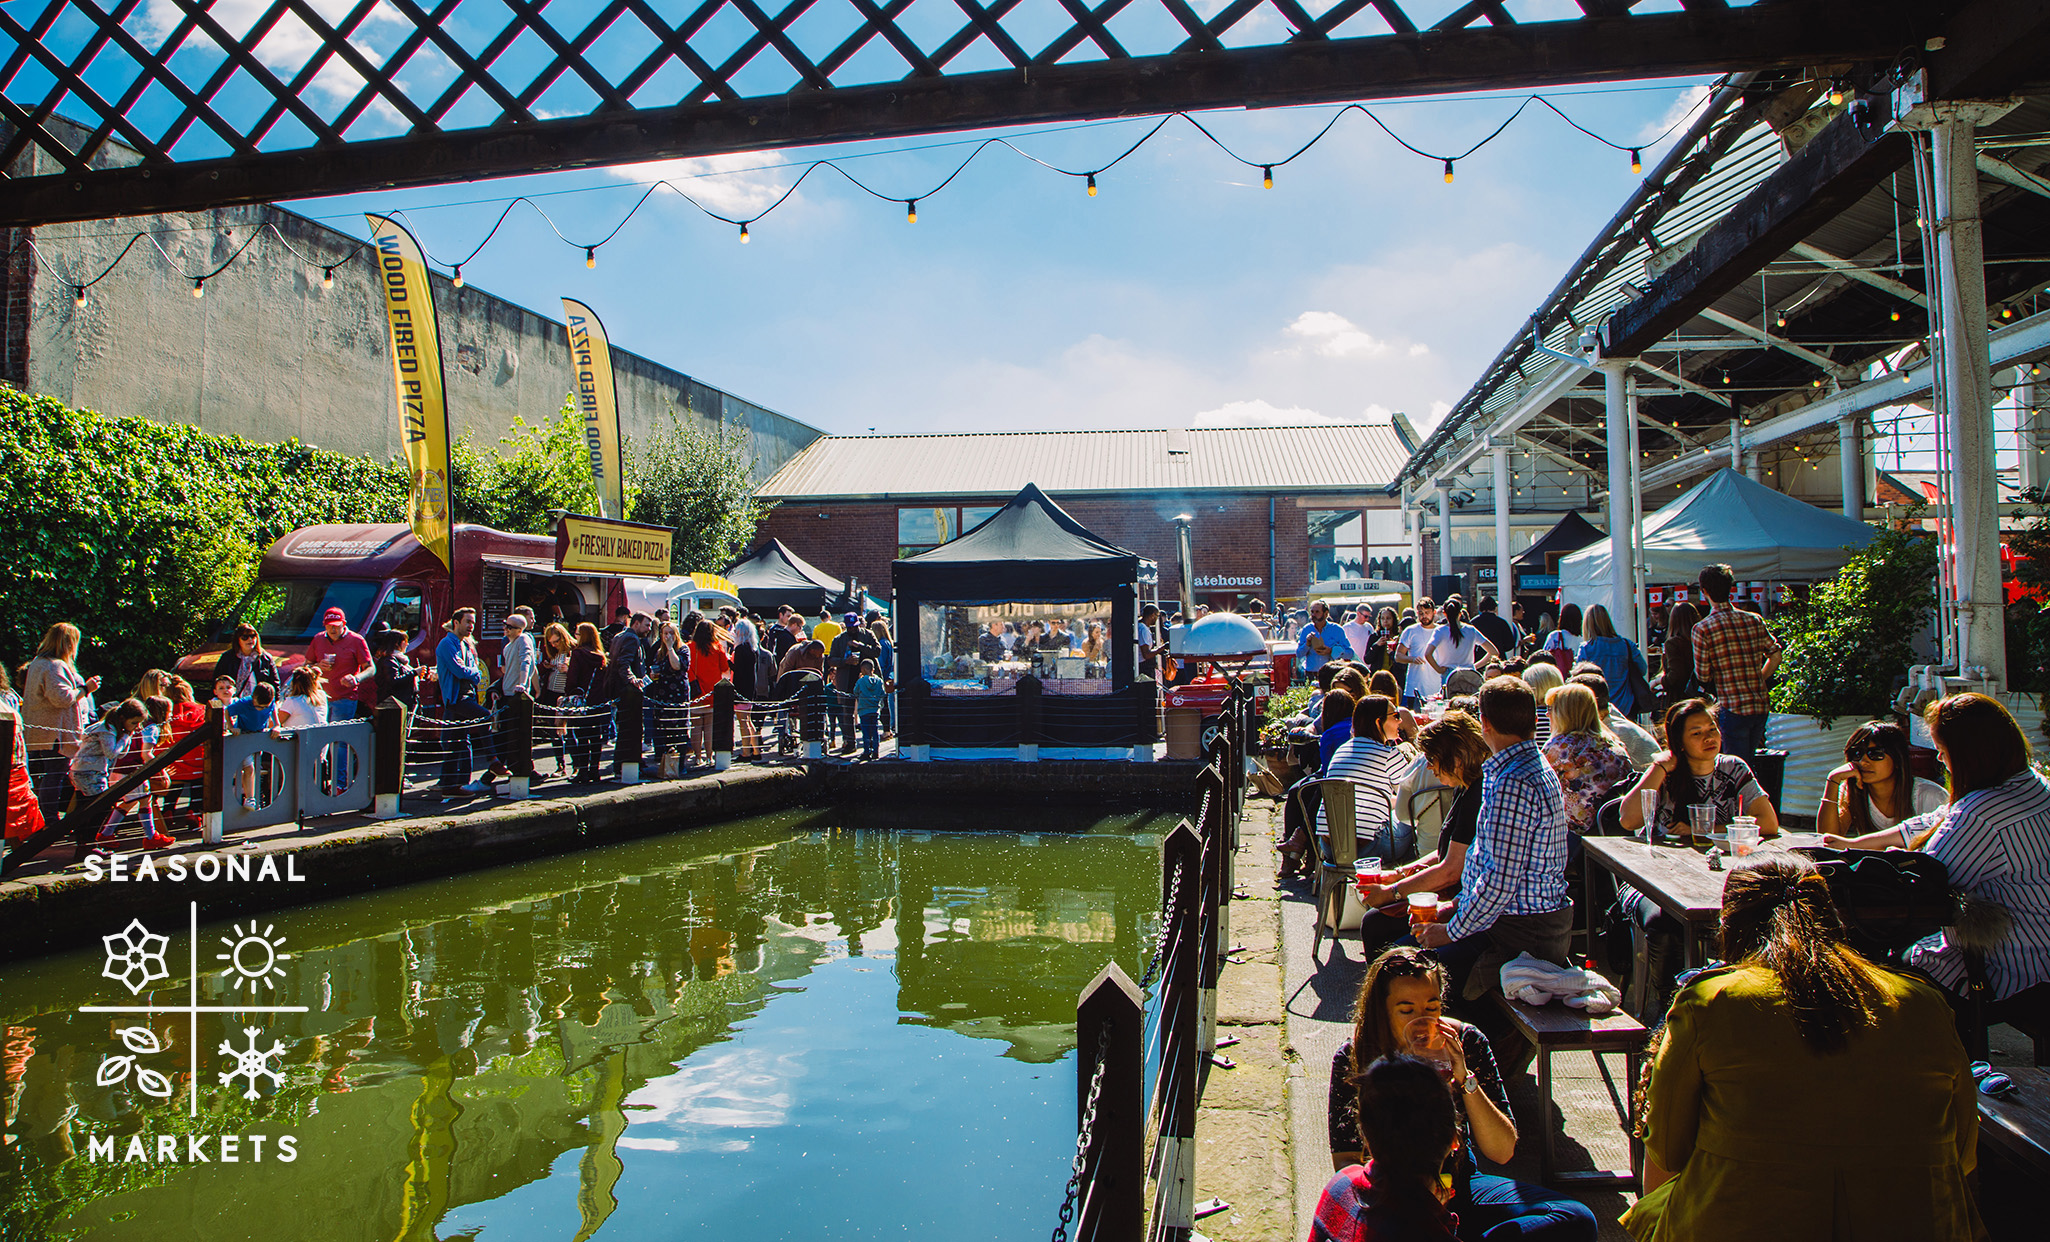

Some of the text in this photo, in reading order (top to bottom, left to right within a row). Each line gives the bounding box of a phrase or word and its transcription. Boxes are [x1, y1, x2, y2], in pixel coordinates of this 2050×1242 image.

[377, 234, 426, 444] WOOD FIRED PIZZA
[297, 540, 328, 549] BARE
[324, 540, 362, 549] BONES
[579, 533, 664, 561] FRESHLY BAKED PIZZA
[1193, 574, 1263, 587] atehouse
